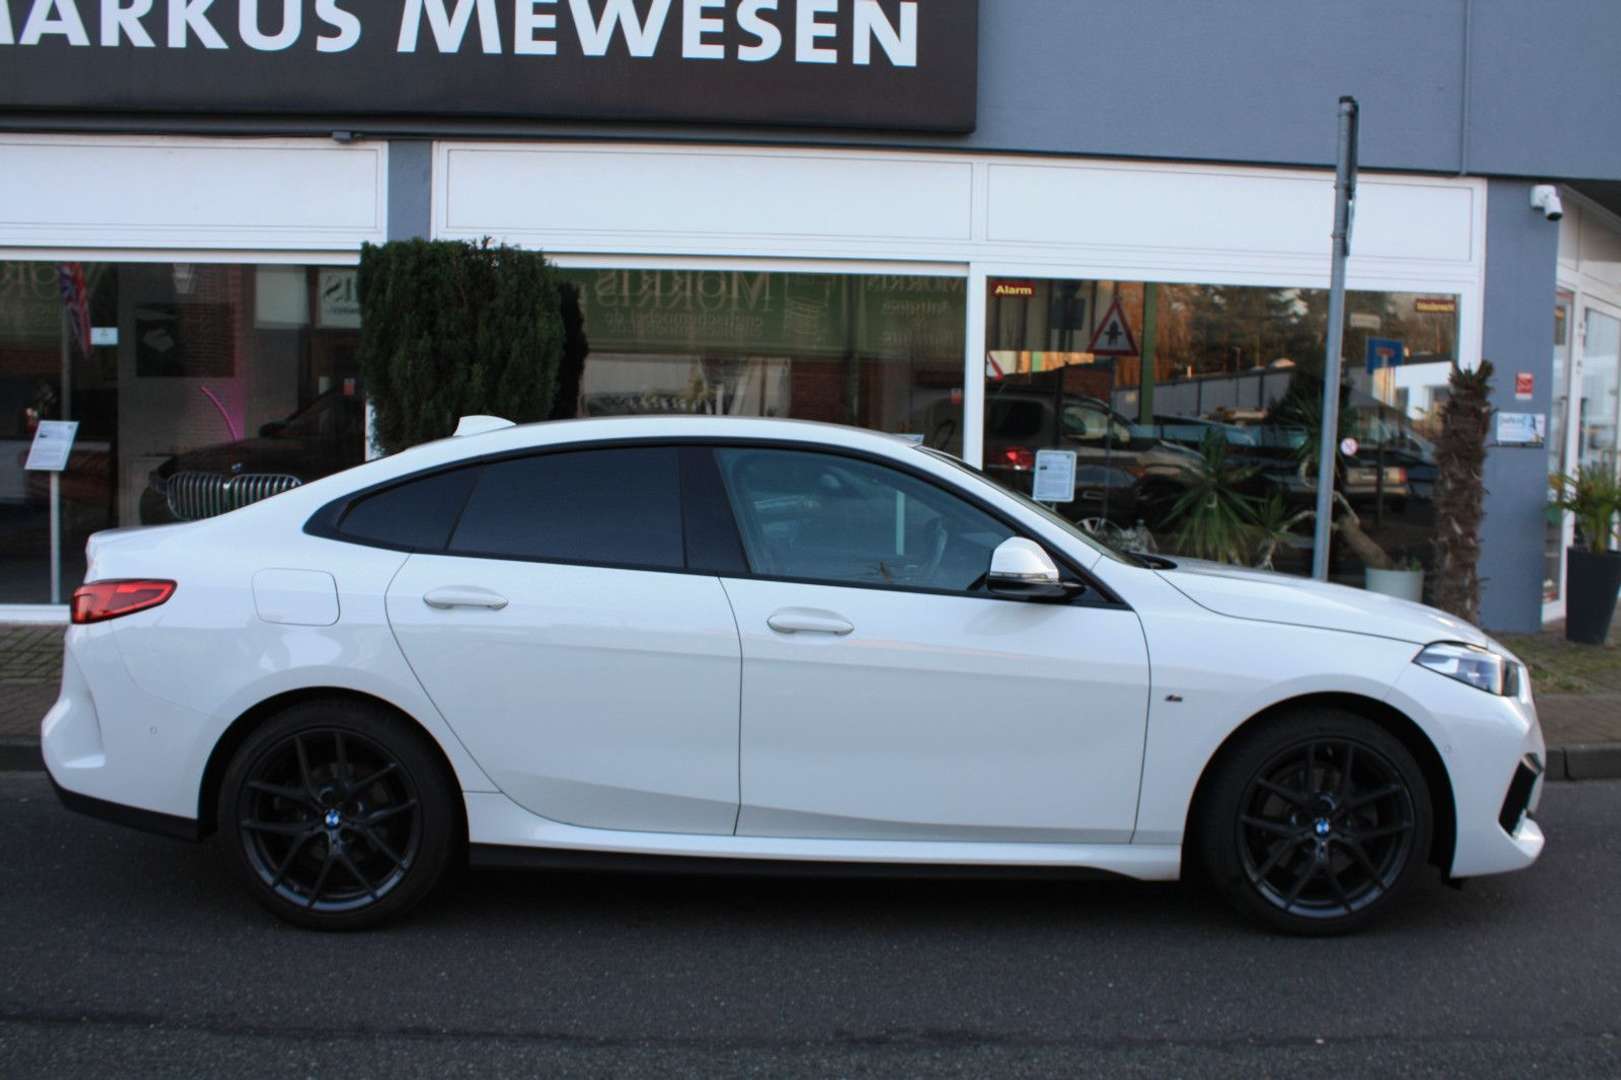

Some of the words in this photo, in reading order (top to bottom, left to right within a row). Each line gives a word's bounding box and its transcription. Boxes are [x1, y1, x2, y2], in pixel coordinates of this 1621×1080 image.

[0, 0, 361, 52] ARKUS
[397, 0, 918, 67] MEWESEN
[995, 285, 1032, 295] Alarm
